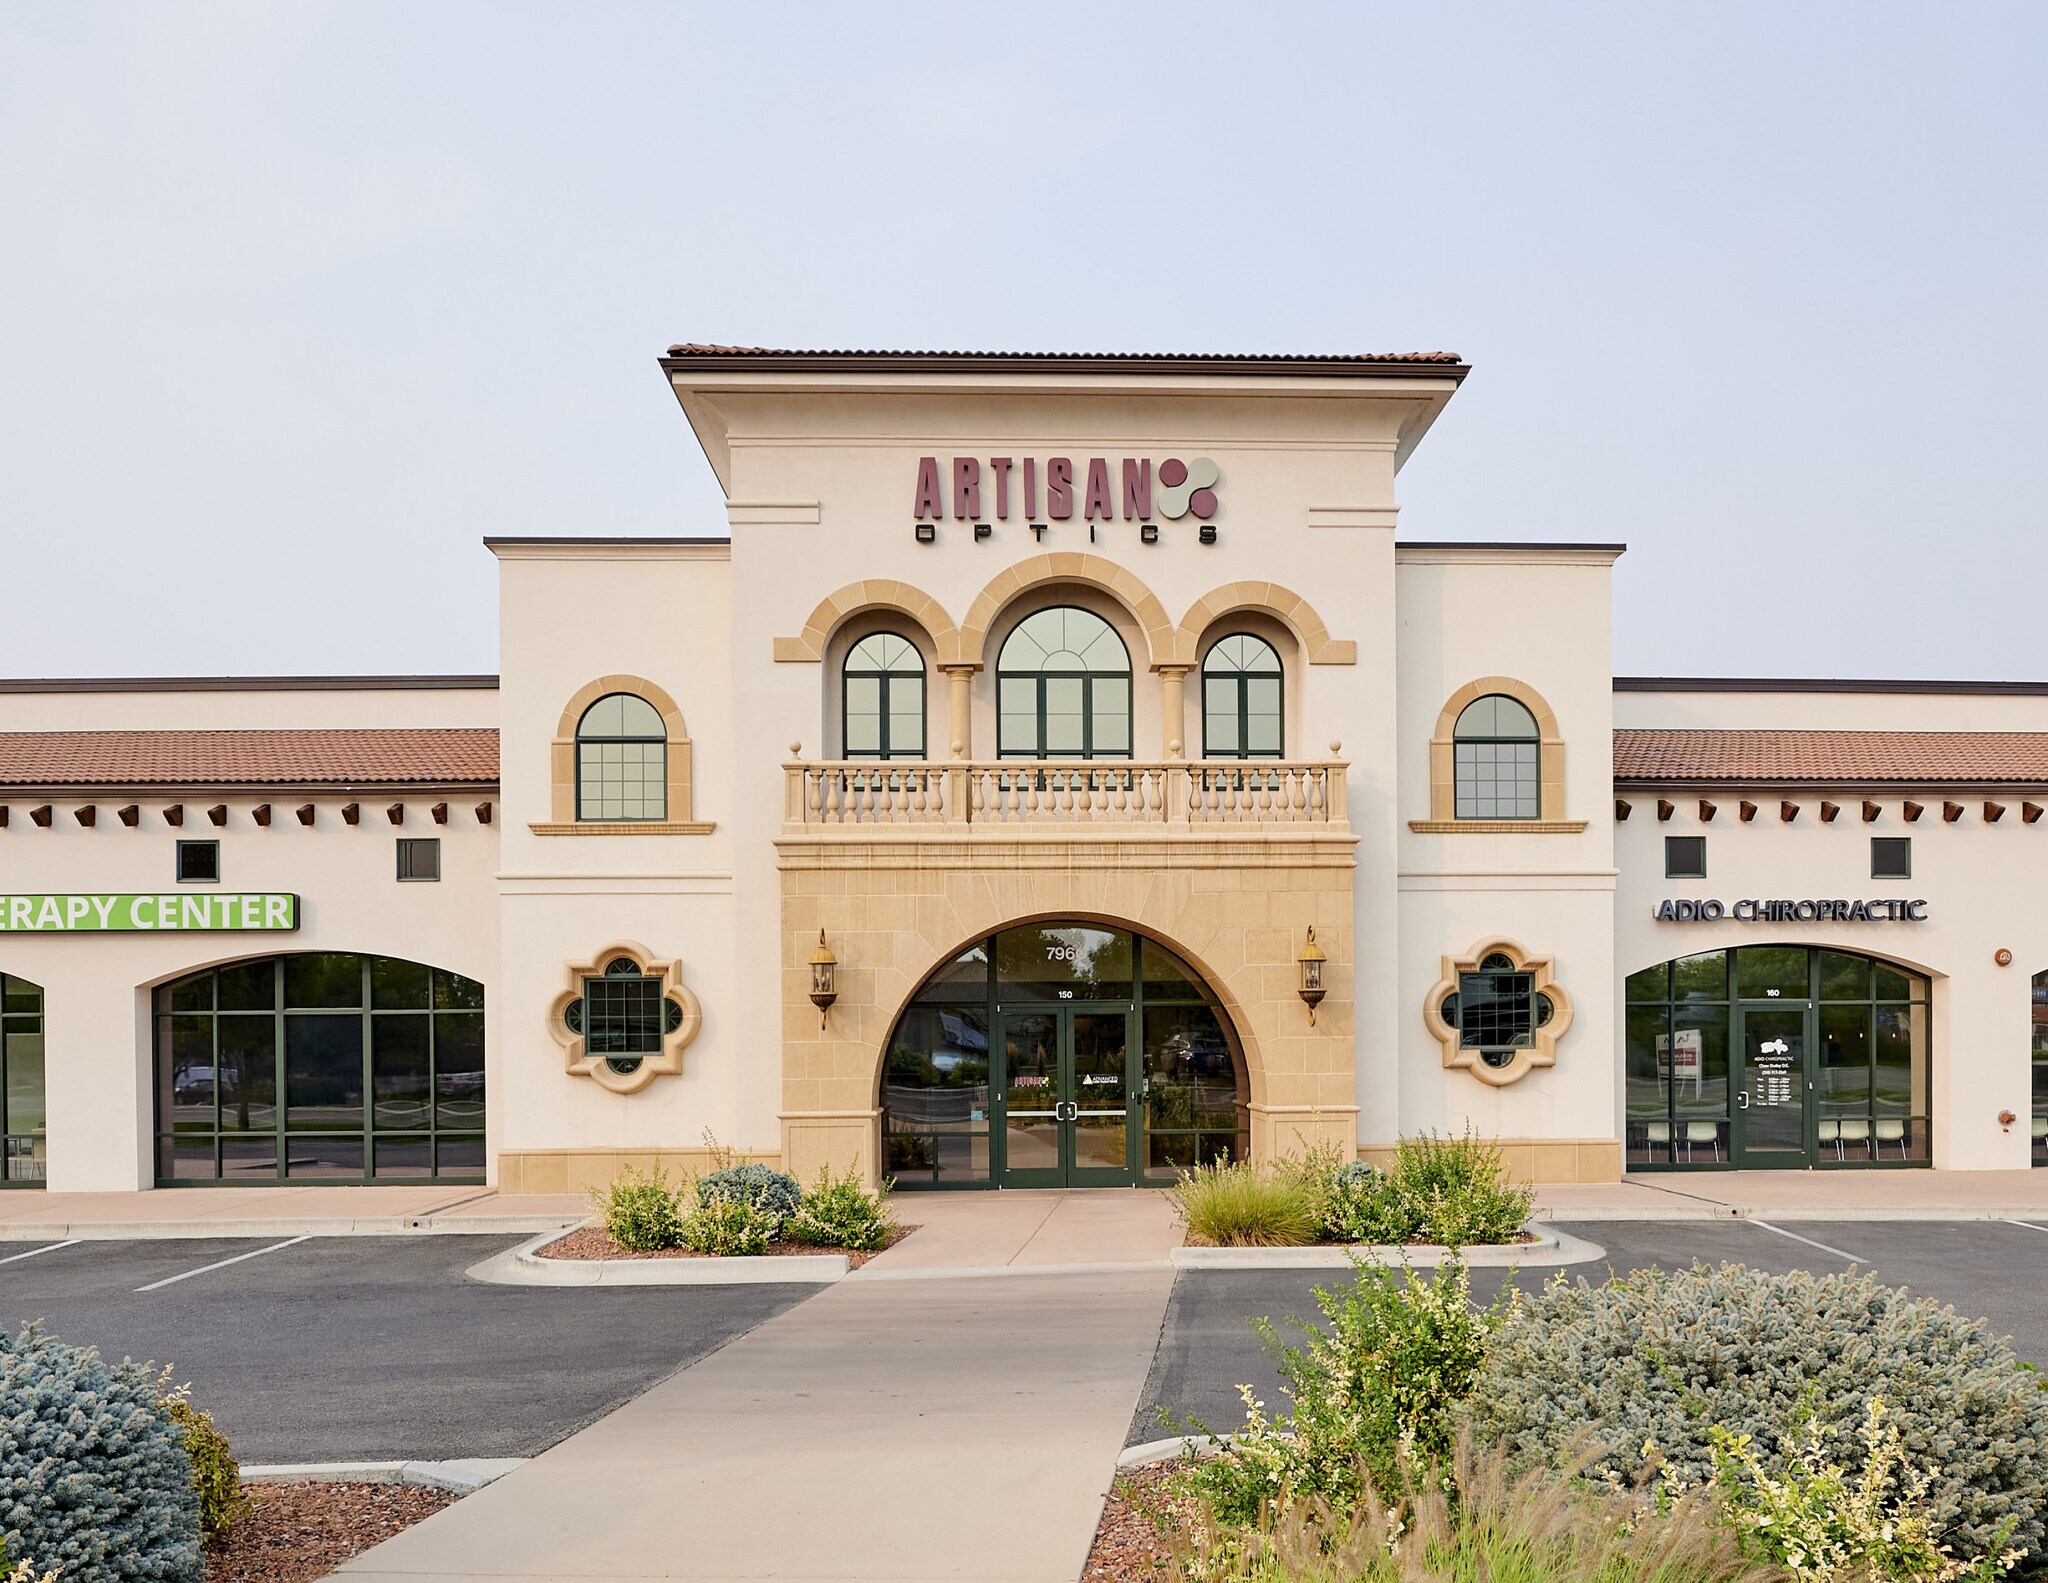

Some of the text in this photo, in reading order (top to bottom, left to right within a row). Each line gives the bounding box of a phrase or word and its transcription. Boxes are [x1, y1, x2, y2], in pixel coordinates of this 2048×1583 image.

[914, 457, 1151, 520] ARTISAN
[915, 524, 1217, 544] OPTICS
[0, 896, 291, 929] RAPY CENTER
[1656, 899, 1928, 922] ADIO CHIROPRACTIC
[1046, 946, 1086, 960] 796
[1058, 990, 1073, 999] 150
[1766, 989, 1780, 997] 160
